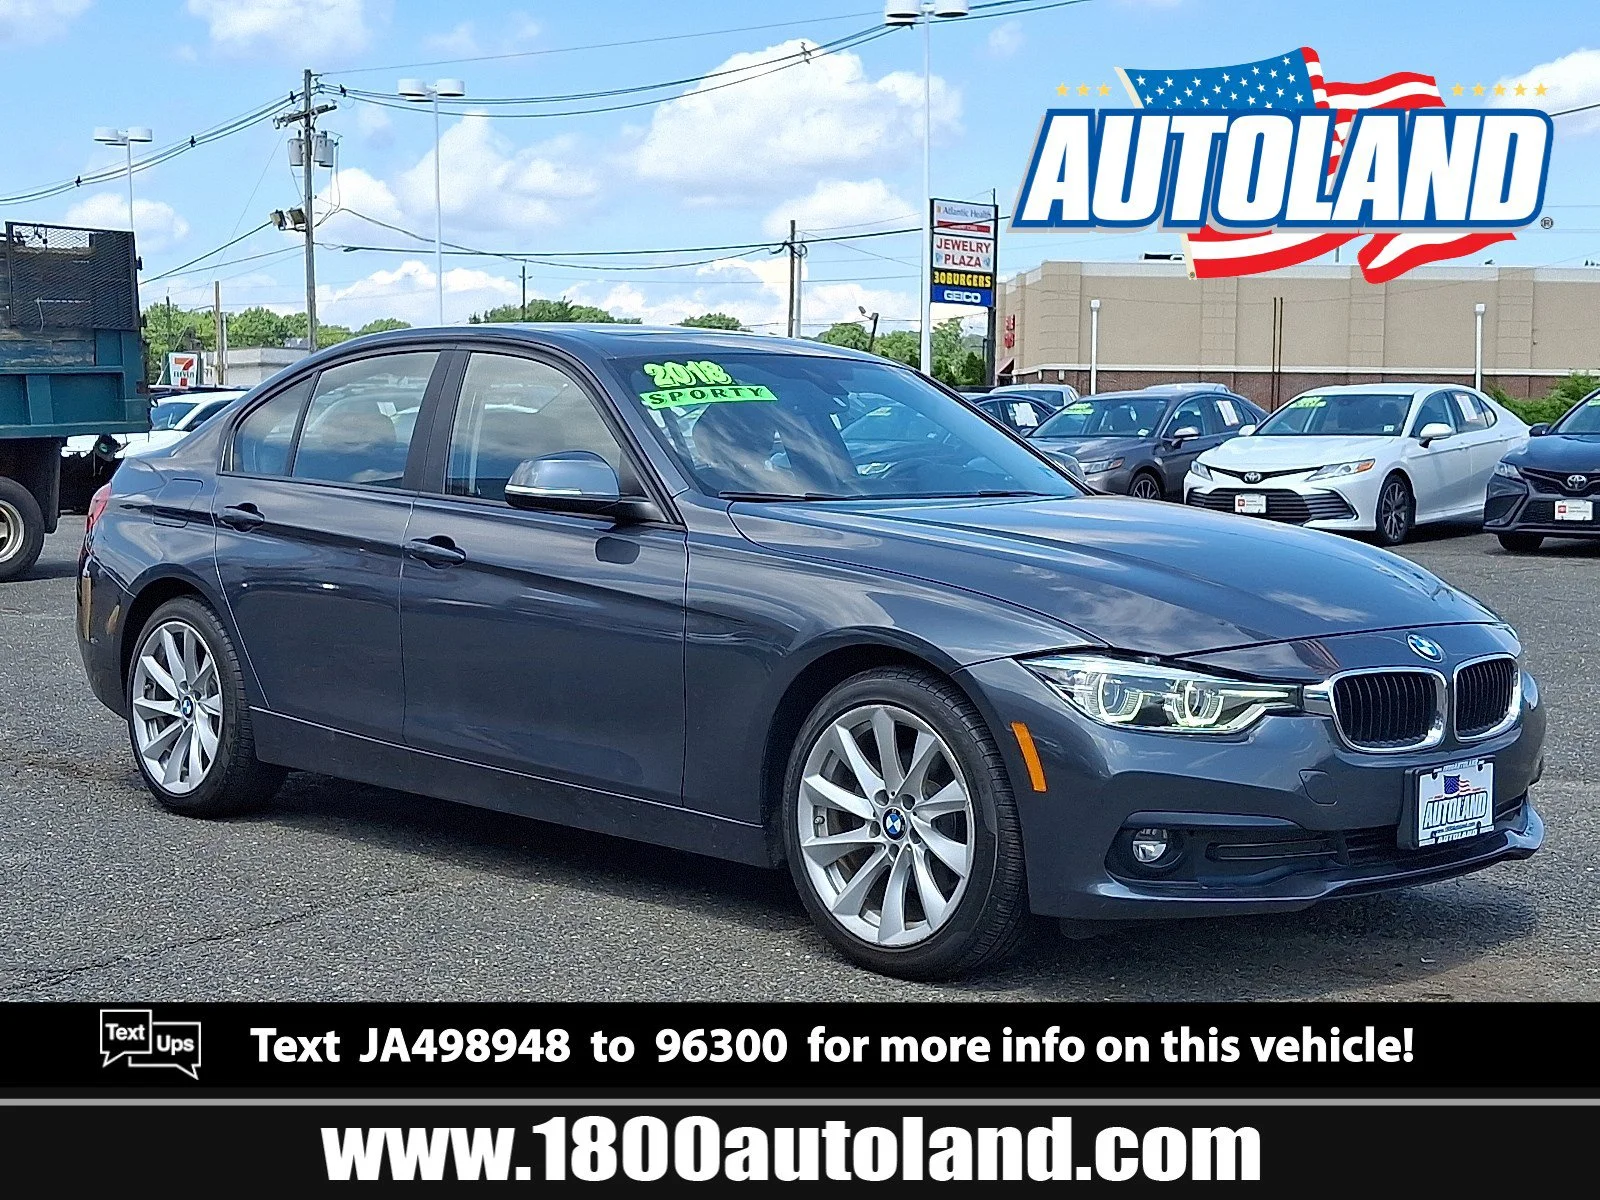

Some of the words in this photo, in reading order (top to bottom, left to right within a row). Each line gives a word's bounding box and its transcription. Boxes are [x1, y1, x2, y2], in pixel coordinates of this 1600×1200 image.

[943, 207, 969, 217] Atlantic
[970, 209, 992, 219] Health
[936, 239, 991, 253] JEWELRY
[944, 254, 982, 267] PLAZA
[934, 271, 991, 287] 30BURGERS
[944, 290, 981, 302] GEICO
[643, 360, 734, 388] 2018
[648, 387, 763, 405] SPORTY
[1423, 791, 1488, 830] AUTOLAND
[1437, 829, 1477, 843] AUTOLAND
